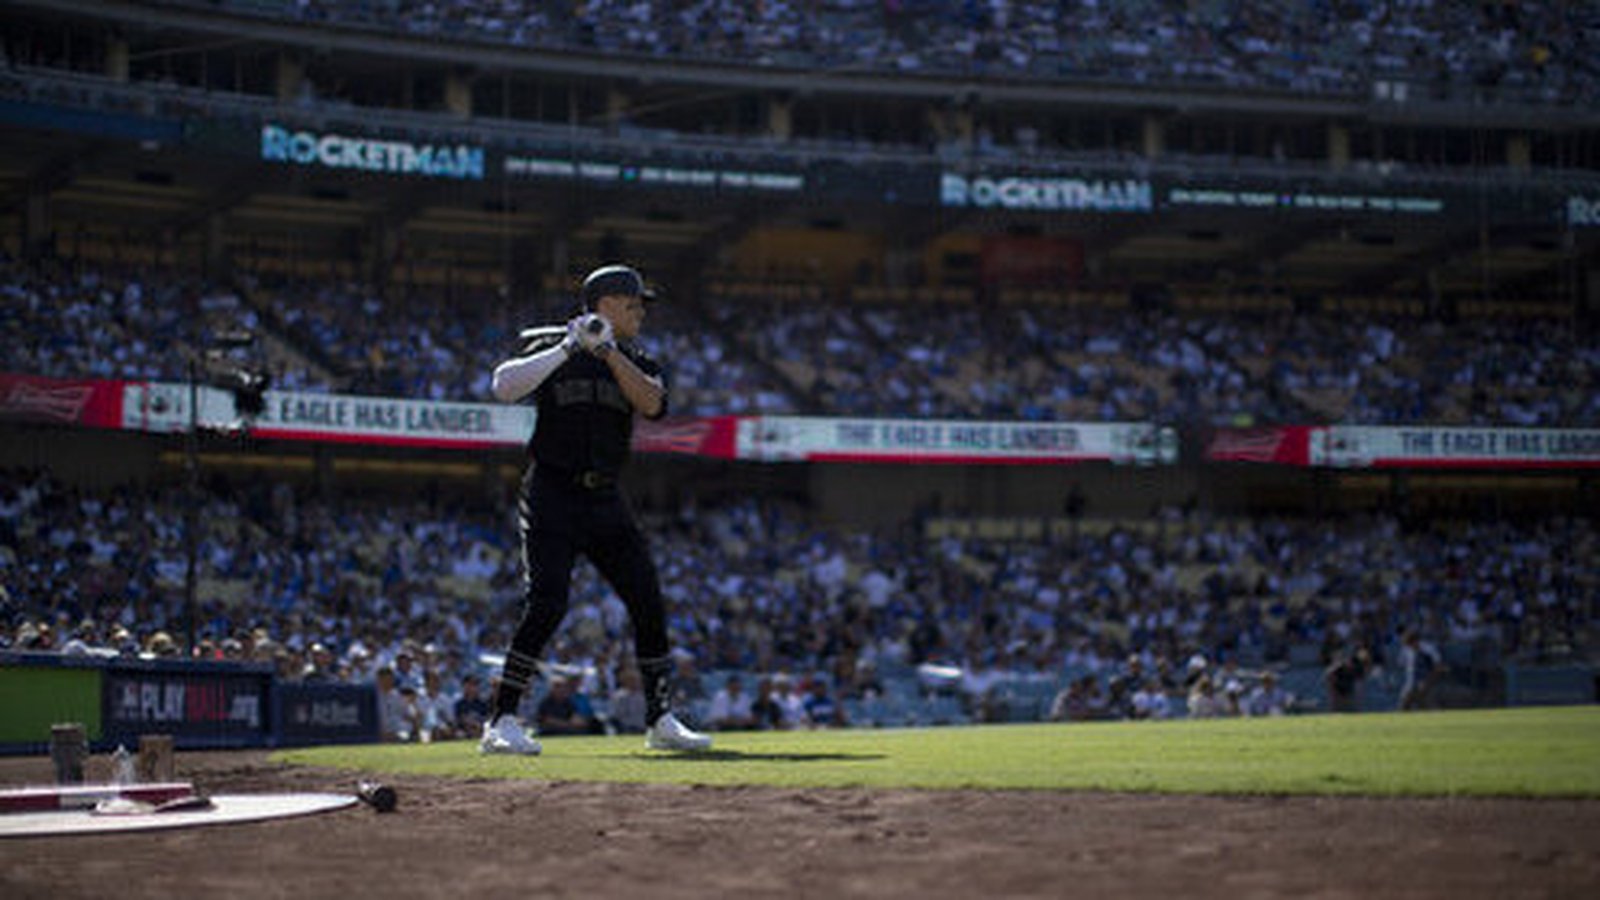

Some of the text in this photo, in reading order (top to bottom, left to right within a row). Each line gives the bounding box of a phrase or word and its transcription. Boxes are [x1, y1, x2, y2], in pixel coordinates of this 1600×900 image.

[262, 125, 484, 179] ROCKETMAN
[941, 173, 1152, 212] ROCKETMAN
[280, 399, 347, 425] EAGLE
[355, 404, 398, 428] HAS
[836, 422, 874, 444] THE
[881, 424, 942, 446] EAGLE
[949, 425, 993, 448] HAS
[1399, 430, 1433, 453] THE
[1442, 431, 1498, 454] EAGLE
[1506, 432, 1545, 454] HAS
